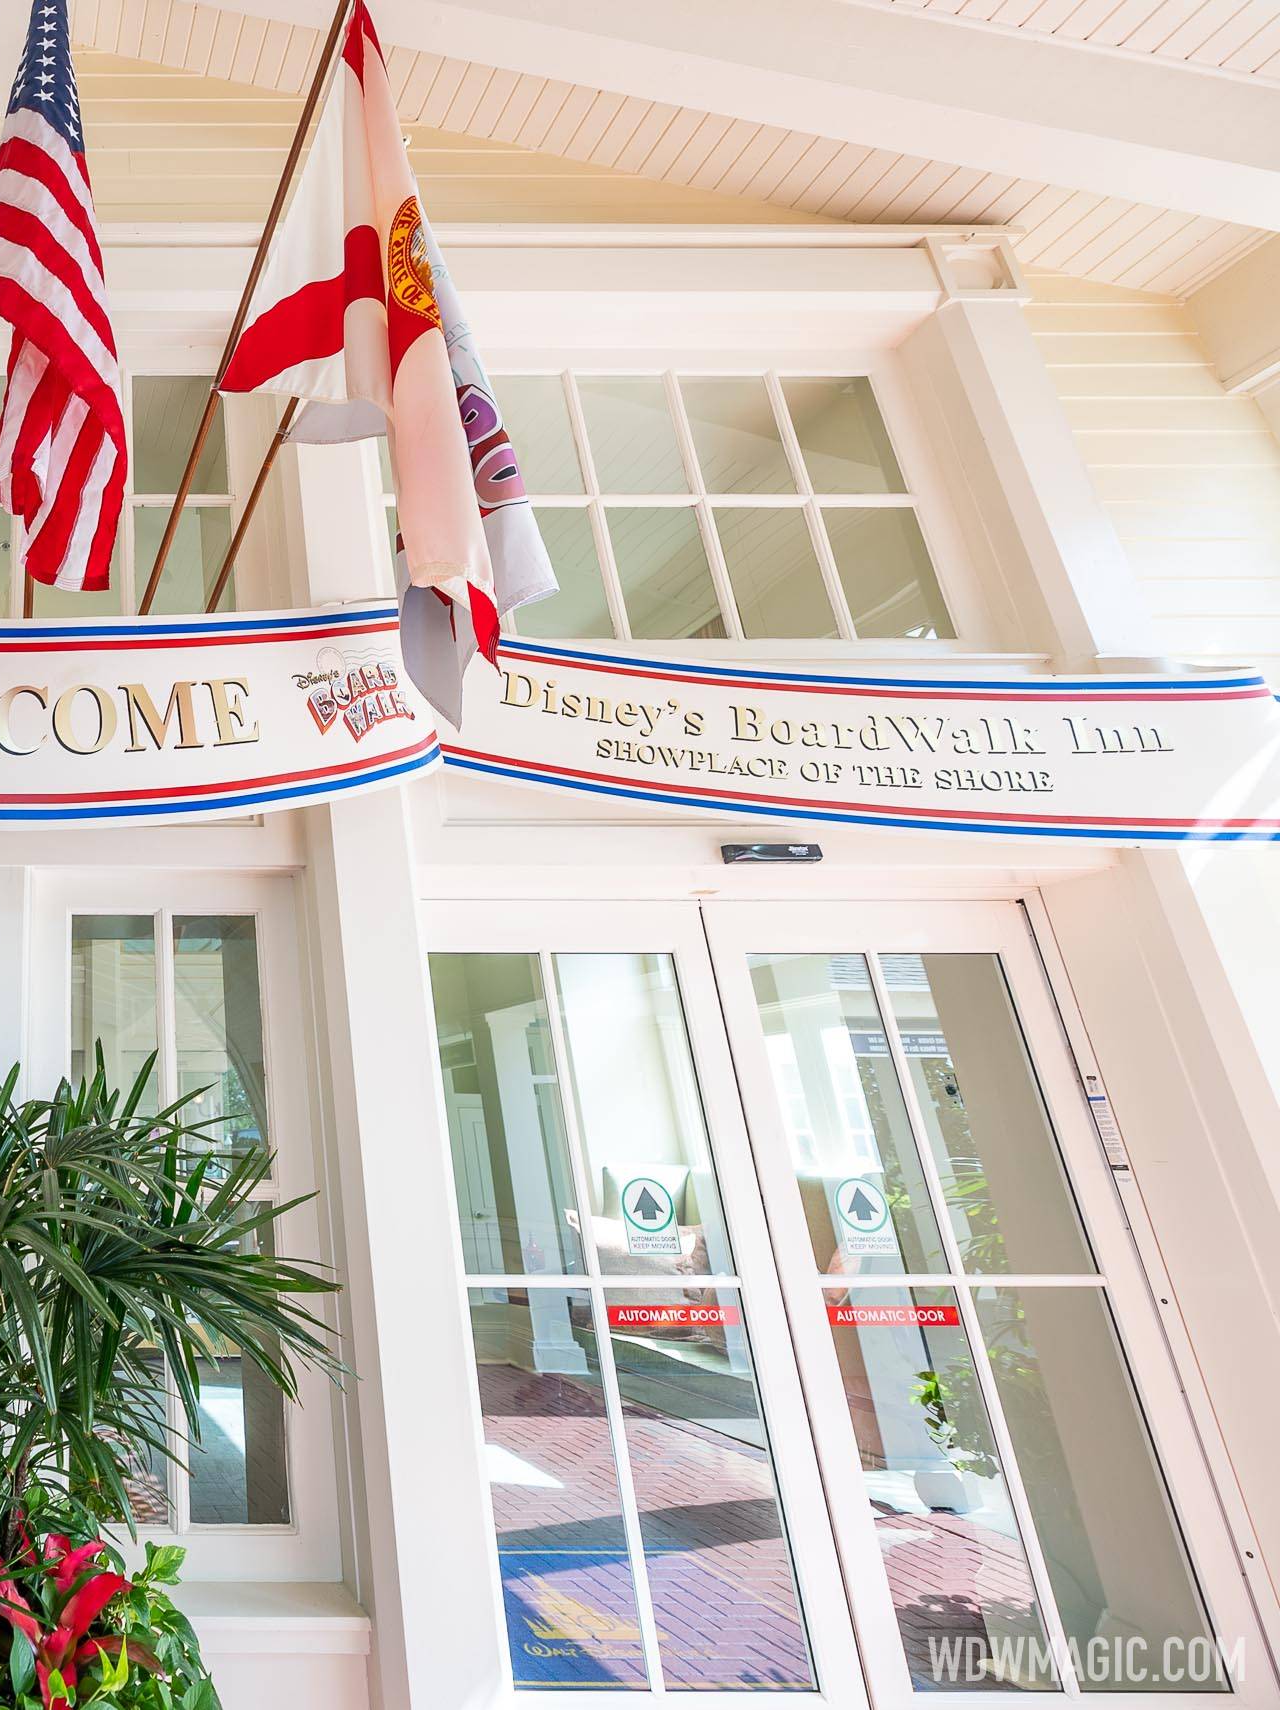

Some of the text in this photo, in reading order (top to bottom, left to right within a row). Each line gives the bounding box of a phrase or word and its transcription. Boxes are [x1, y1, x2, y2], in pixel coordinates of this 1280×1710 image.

[499, 671, 1175, 754] Disney's BoardWalk Inn
[596, 738, 1054, 792] SHOWPLACE OF THE SHORE
[618, 1308, 727, 1322] AUTOMATIC DOOR
[836, 1308, 945, 1322] AUTOMATIC DOOR
